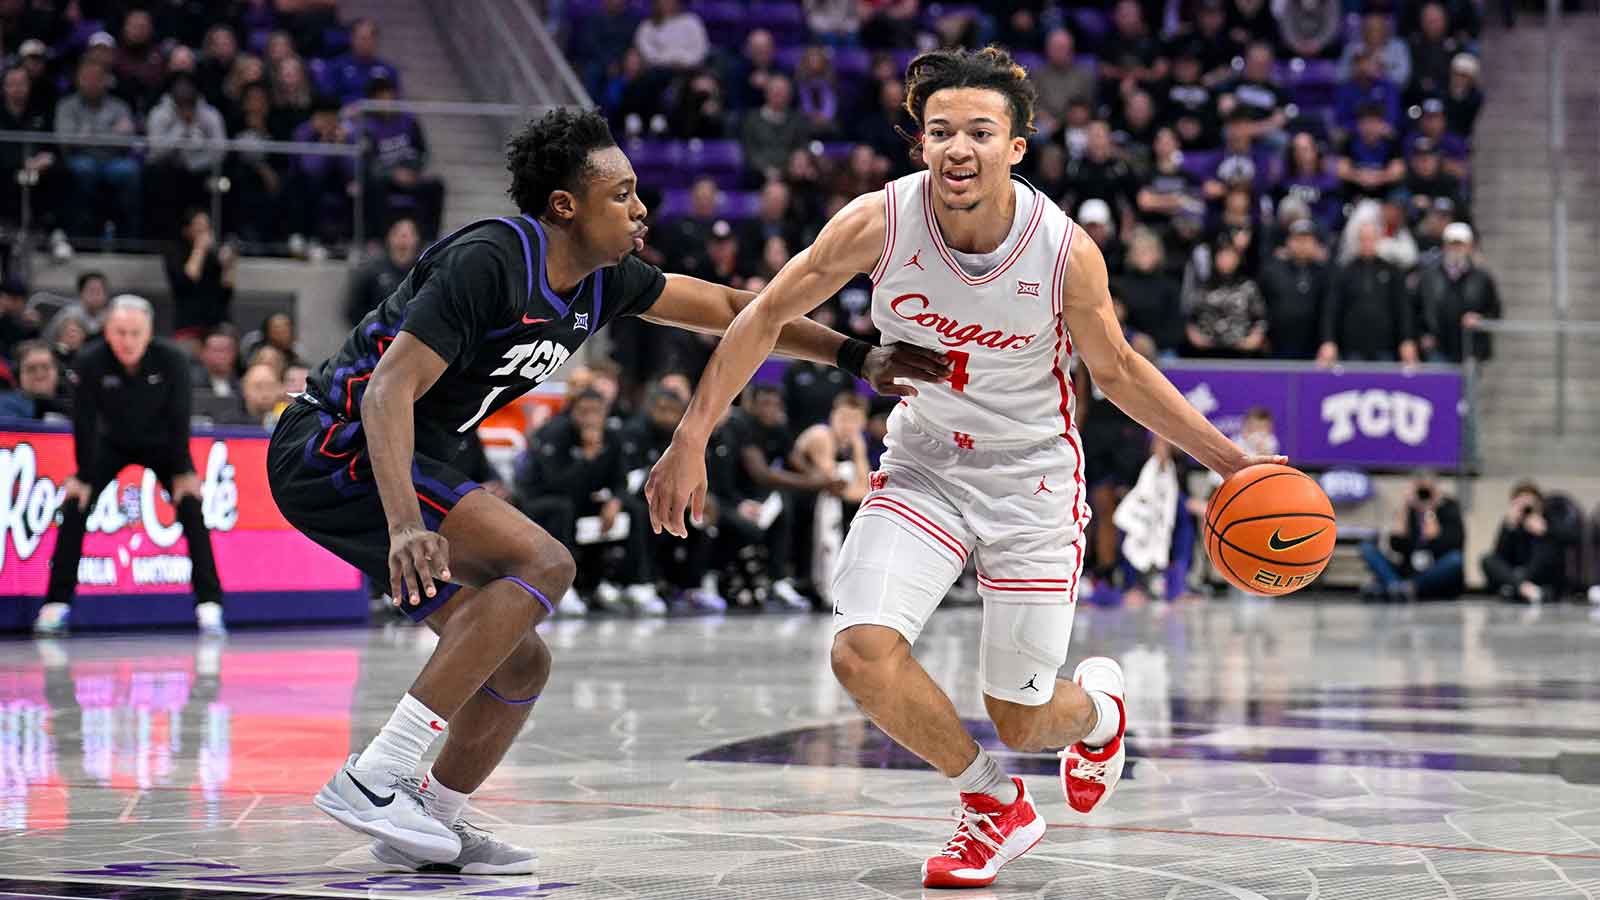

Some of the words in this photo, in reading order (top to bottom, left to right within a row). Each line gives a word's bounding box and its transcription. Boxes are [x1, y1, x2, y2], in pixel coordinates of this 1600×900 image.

[890, 293, 1037, 350] Cougars
[489, 340, 571, 383] TCU
[943, 350, 971, 393] 4
[456, 385, 511, 433] 1
[1321, 388, 1432, 445] TCU
[1254, 568, 1320, 588] ELITE
